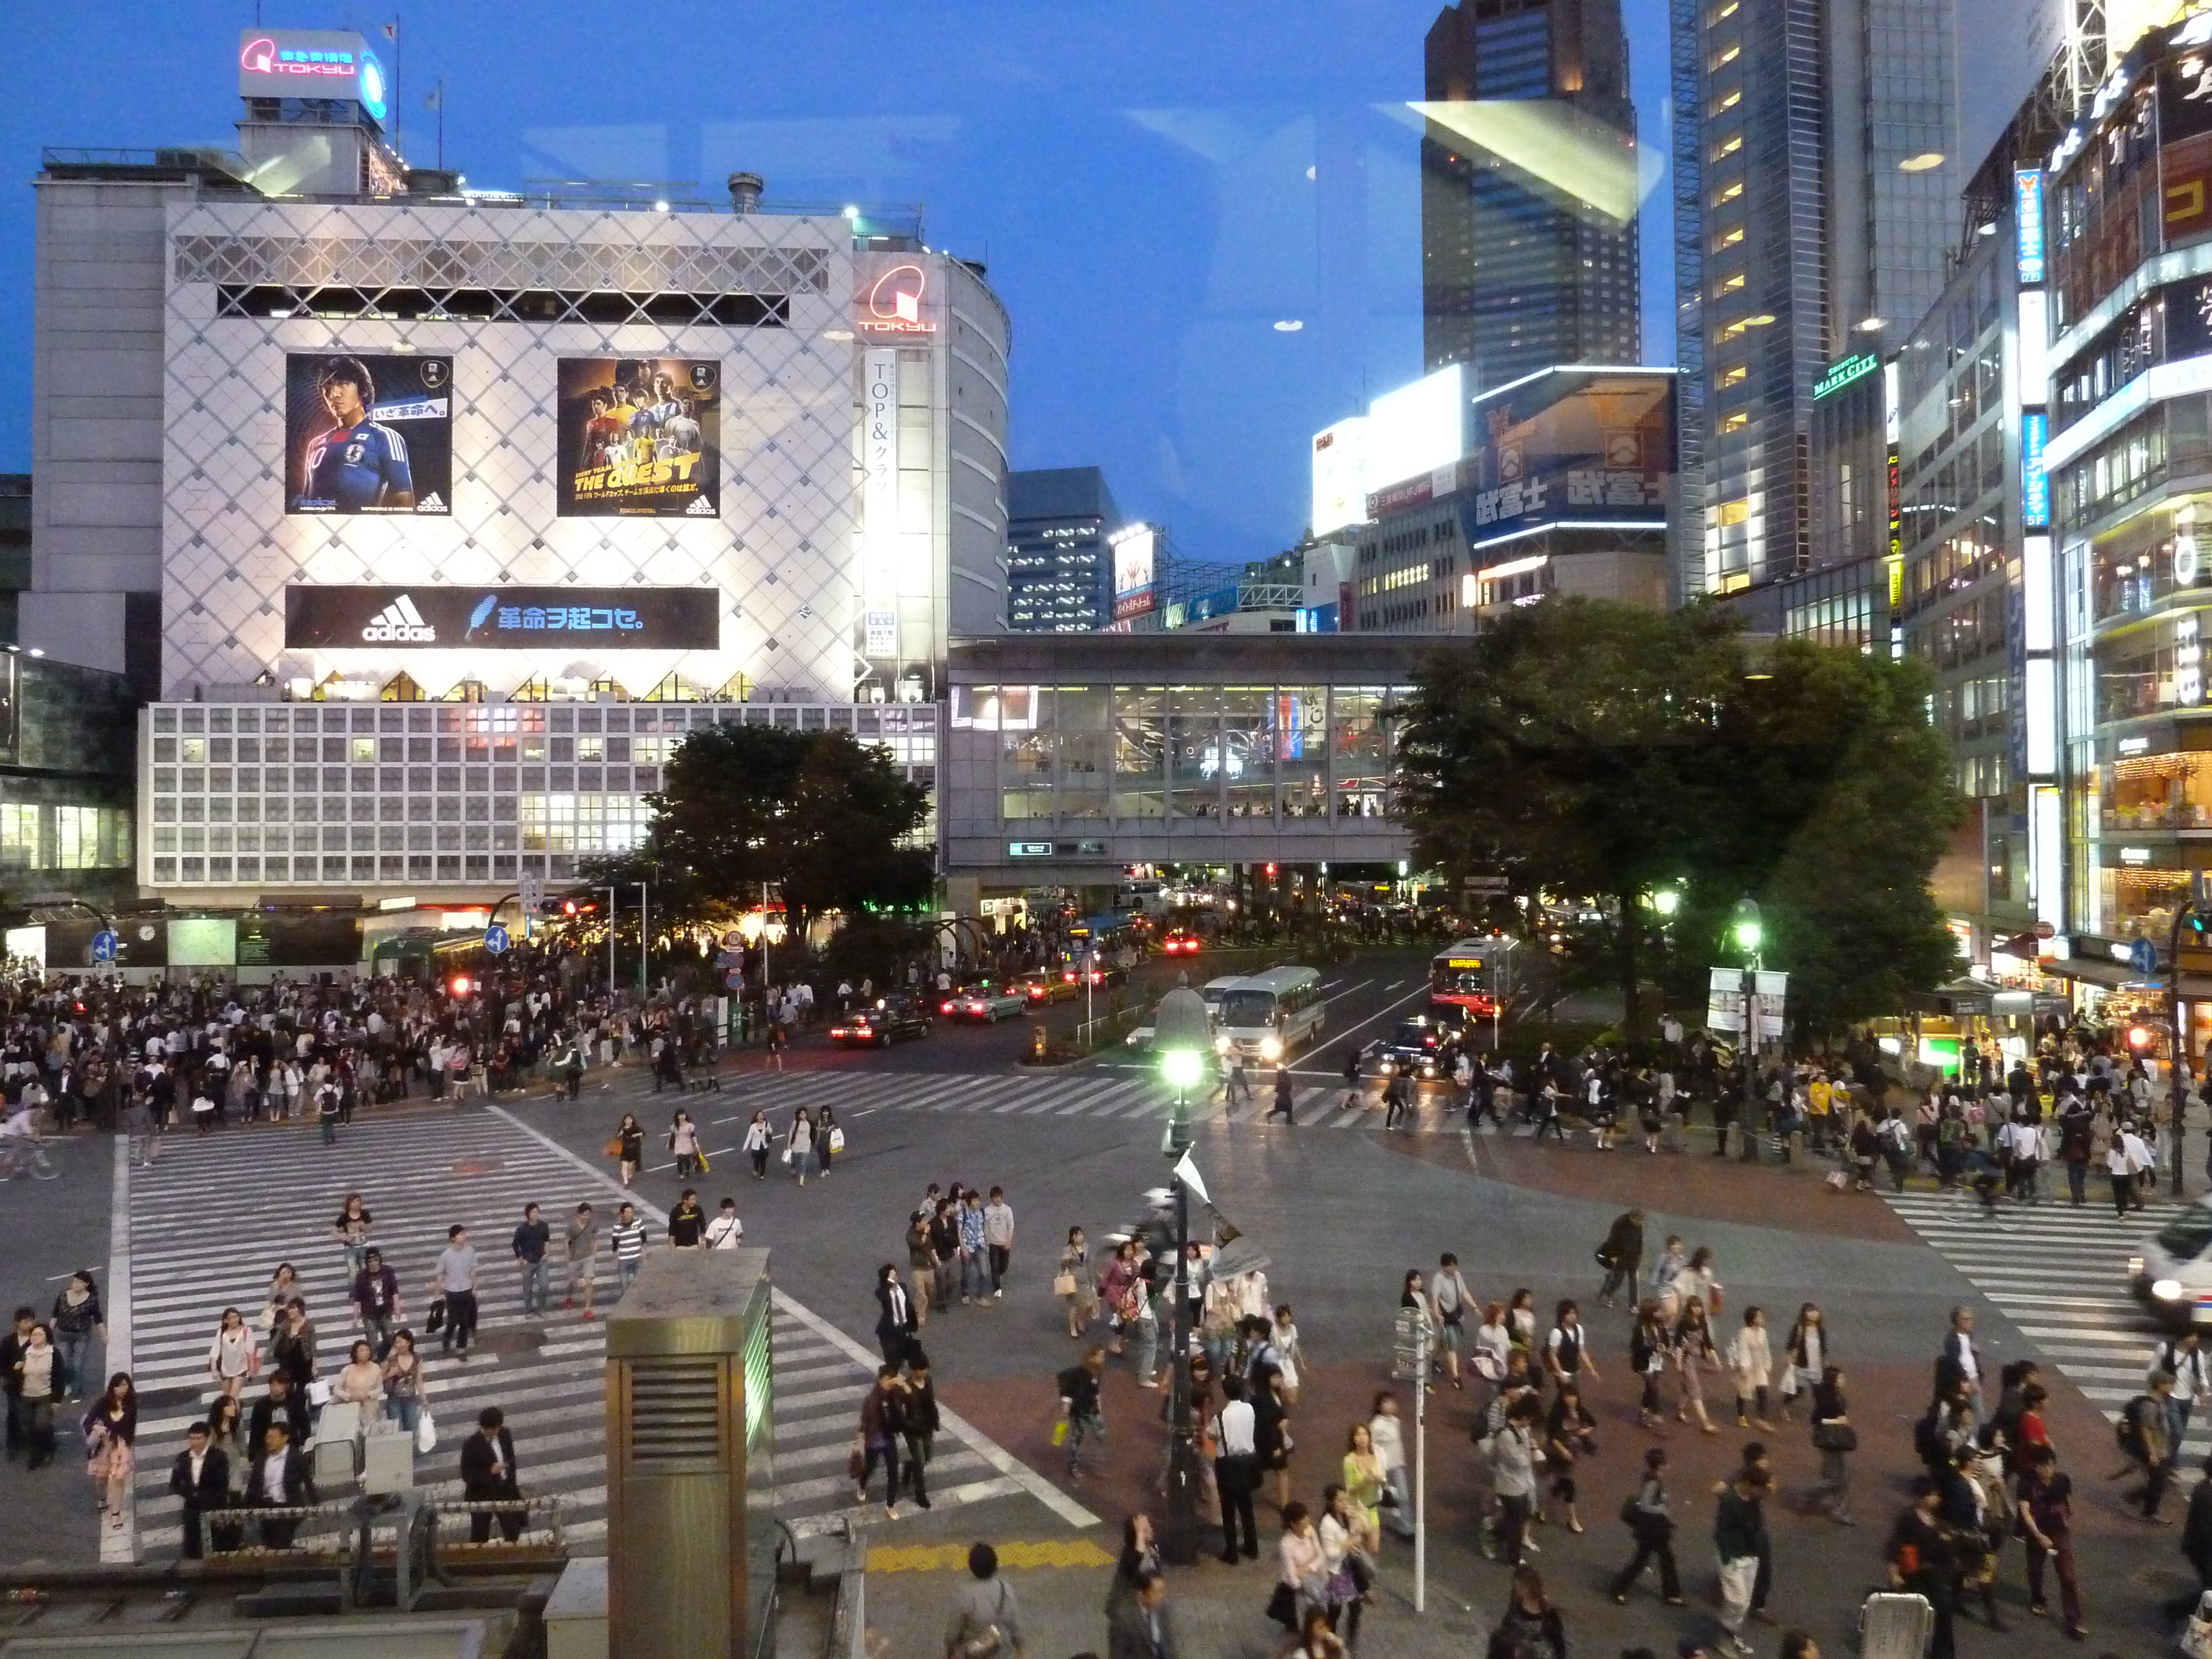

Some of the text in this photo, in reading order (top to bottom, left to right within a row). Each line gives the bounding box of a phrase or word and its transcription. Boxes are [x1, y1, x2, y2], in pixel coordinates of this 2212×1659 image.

[273, 64, 356, 75] TOKYU
[858, 321, 936, 332] TOKYU
[1828, 354, 1859, 376] SHIBUYA
[1814, 354, 1875, 395] MARK CITY
[375, 404, 446, 419] いざ革命へ。
[575, 452, 701, 492] THE QUEST
[593, 464, 612, 474] TEAM
[1568, 470, 1669, 505] 武富士
[417, 504, 448, 512] adidas
[1476, 476, 1548, 525] 武富士
[686, 506, 716, 515] adidas
[2027, 515, 2045, 525] 5F
[497, 607, 644, 630] 革命ヲ起コセ。
[362, 624, 436, 642] adidas
